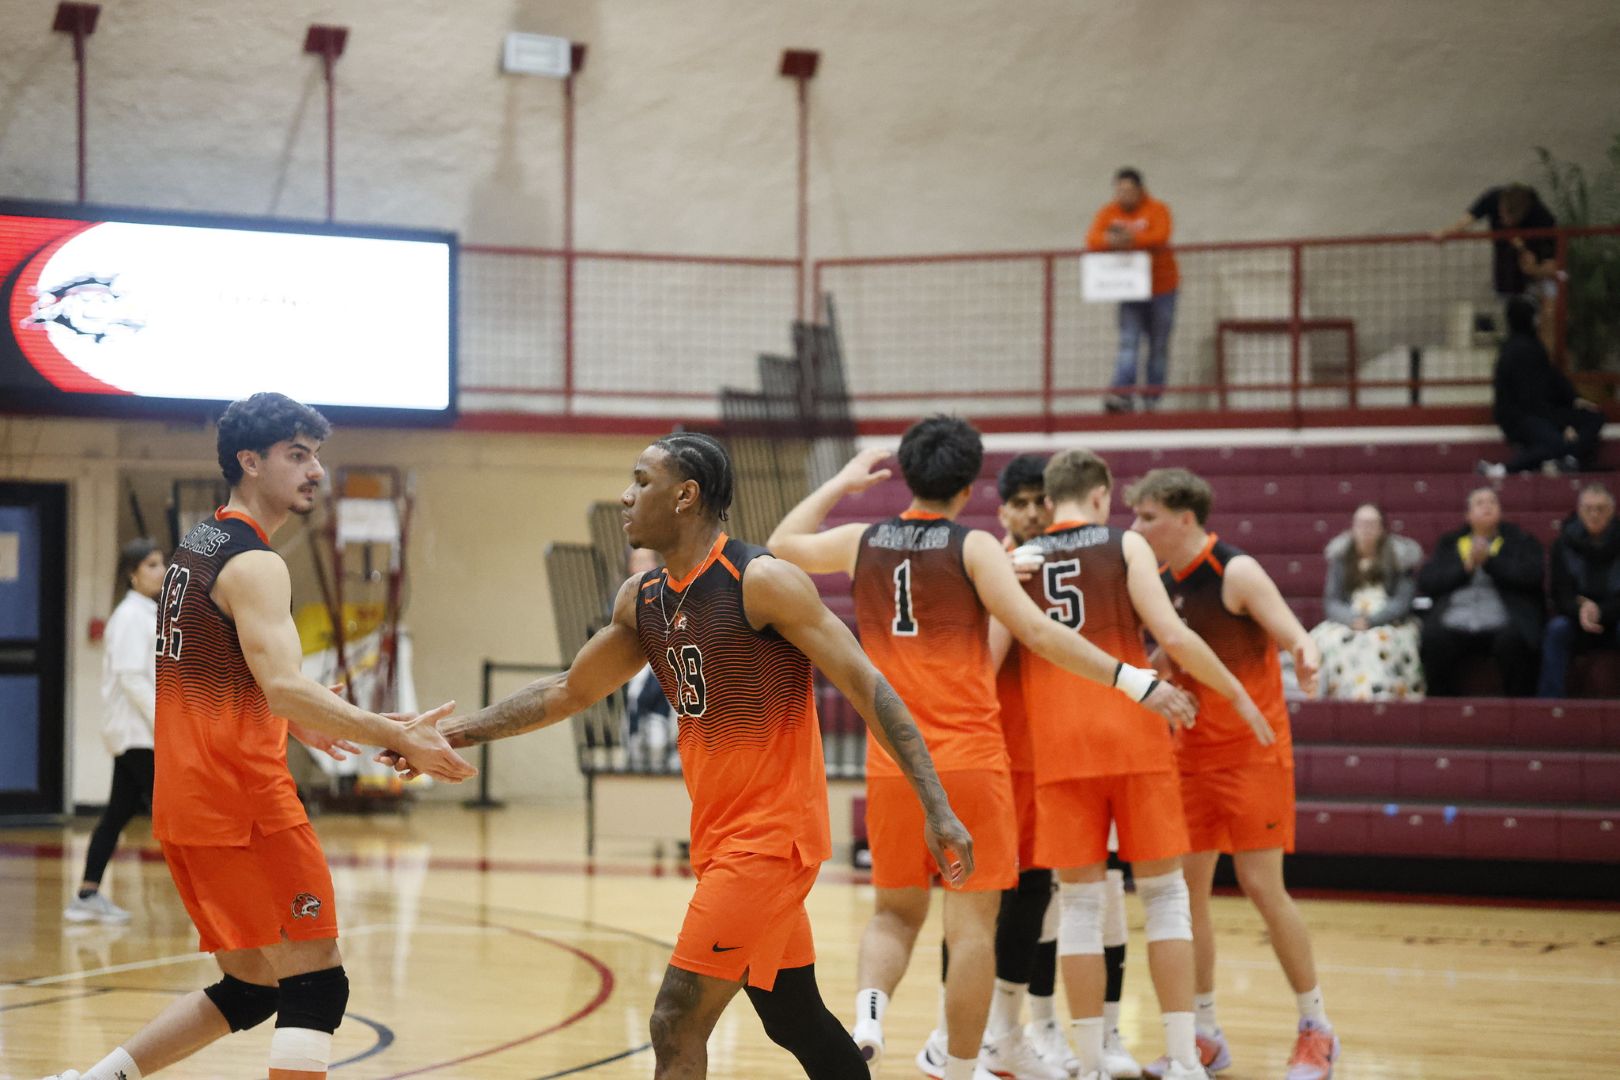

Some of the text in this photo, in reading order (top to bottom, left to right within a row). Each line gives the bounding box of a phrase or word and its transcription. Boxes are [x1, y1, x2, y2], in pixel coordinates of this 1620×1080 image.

[156, 563, 190, 661] 12
[891, 558, 919, 637] 1
[1043, 558, 1086, 633] 5
[666, 645, 708, 718] 19
